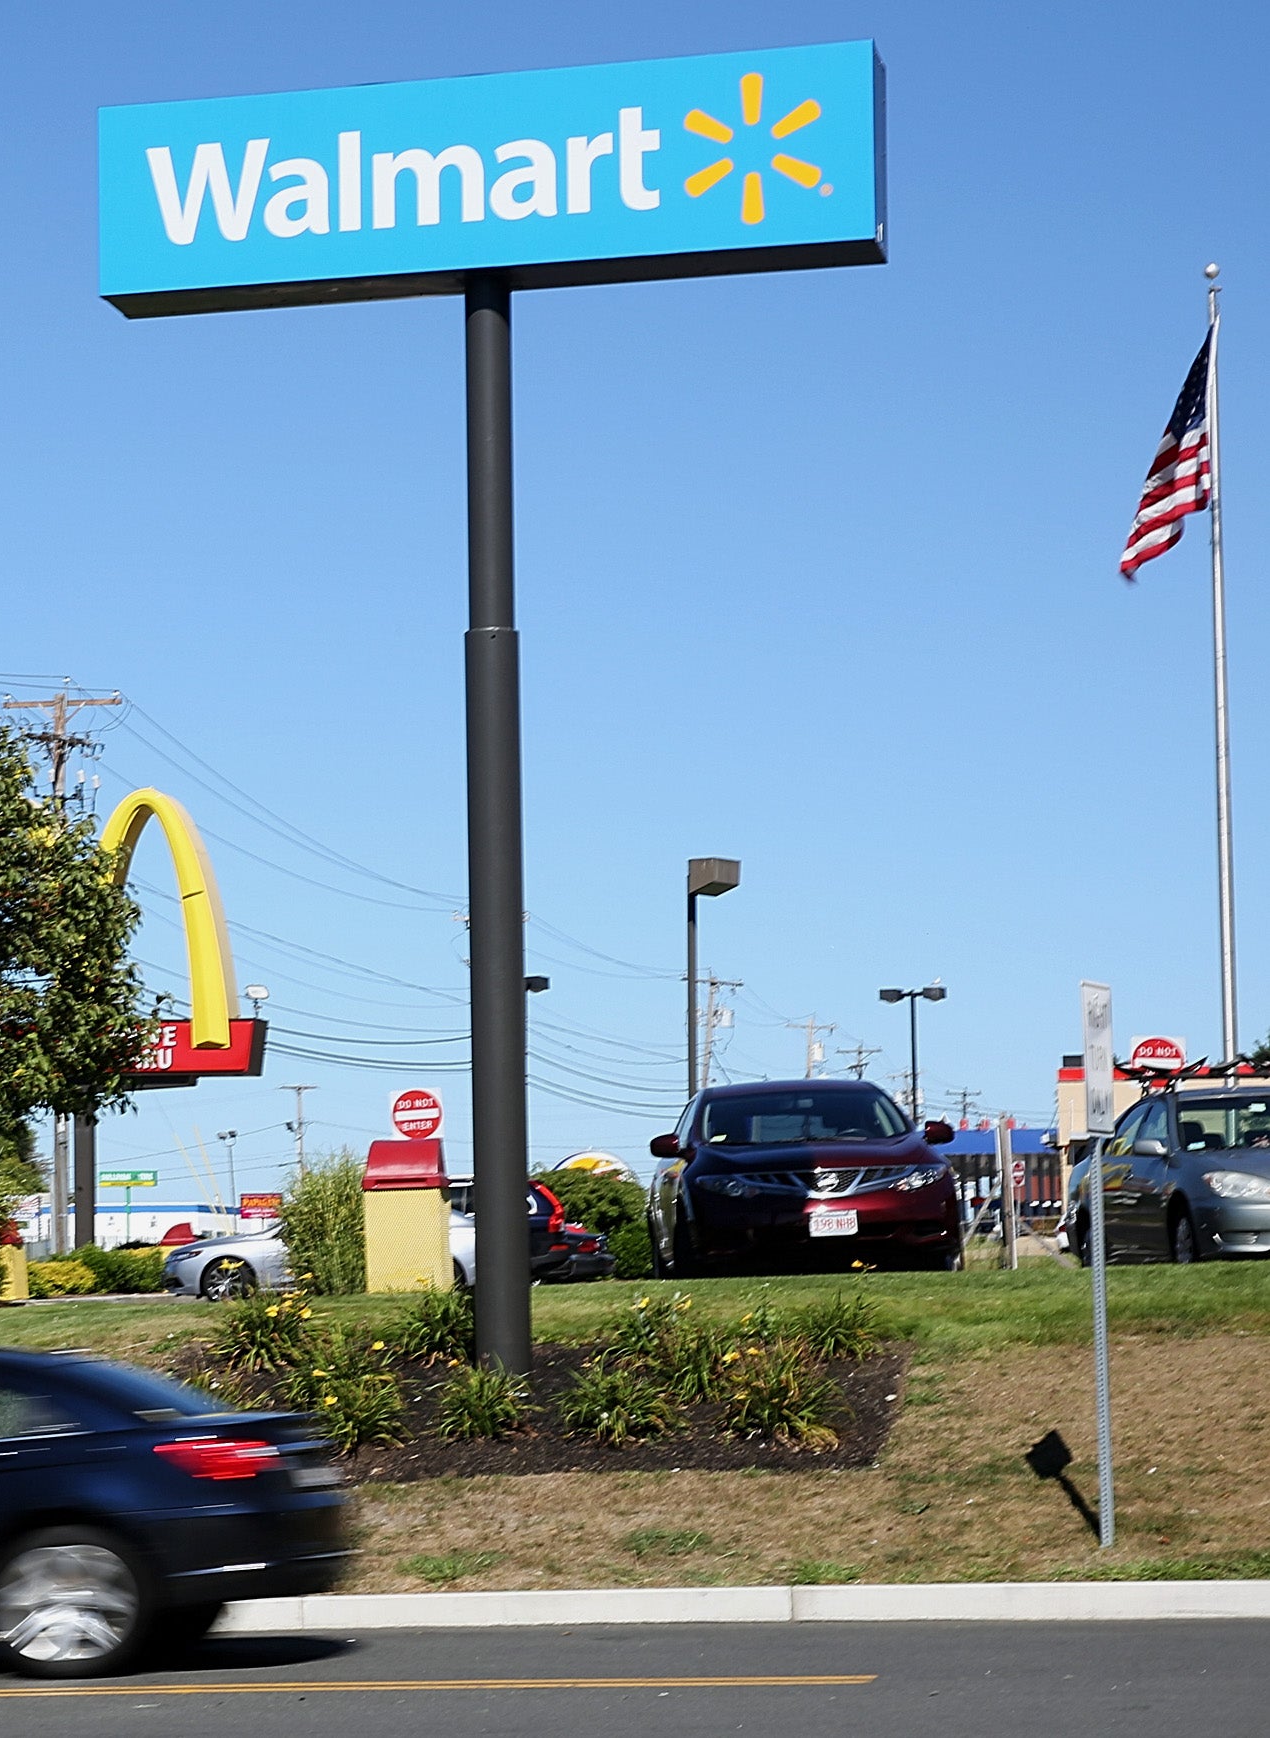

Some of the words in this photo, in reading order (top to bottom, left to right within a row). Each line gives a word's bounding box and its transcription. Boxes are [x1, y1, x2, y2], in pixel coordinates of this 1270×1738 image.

[146, 106, 660, 246] Walmart
[1138, 1047, 1153, 1057] DO
[1156, 1046, 1178, 1056] NOT
[397, 1099, 412, 1109] DO
[415, 1097, 434, 1107] NOT
[402, 1121, 433, 1131] ENTER
